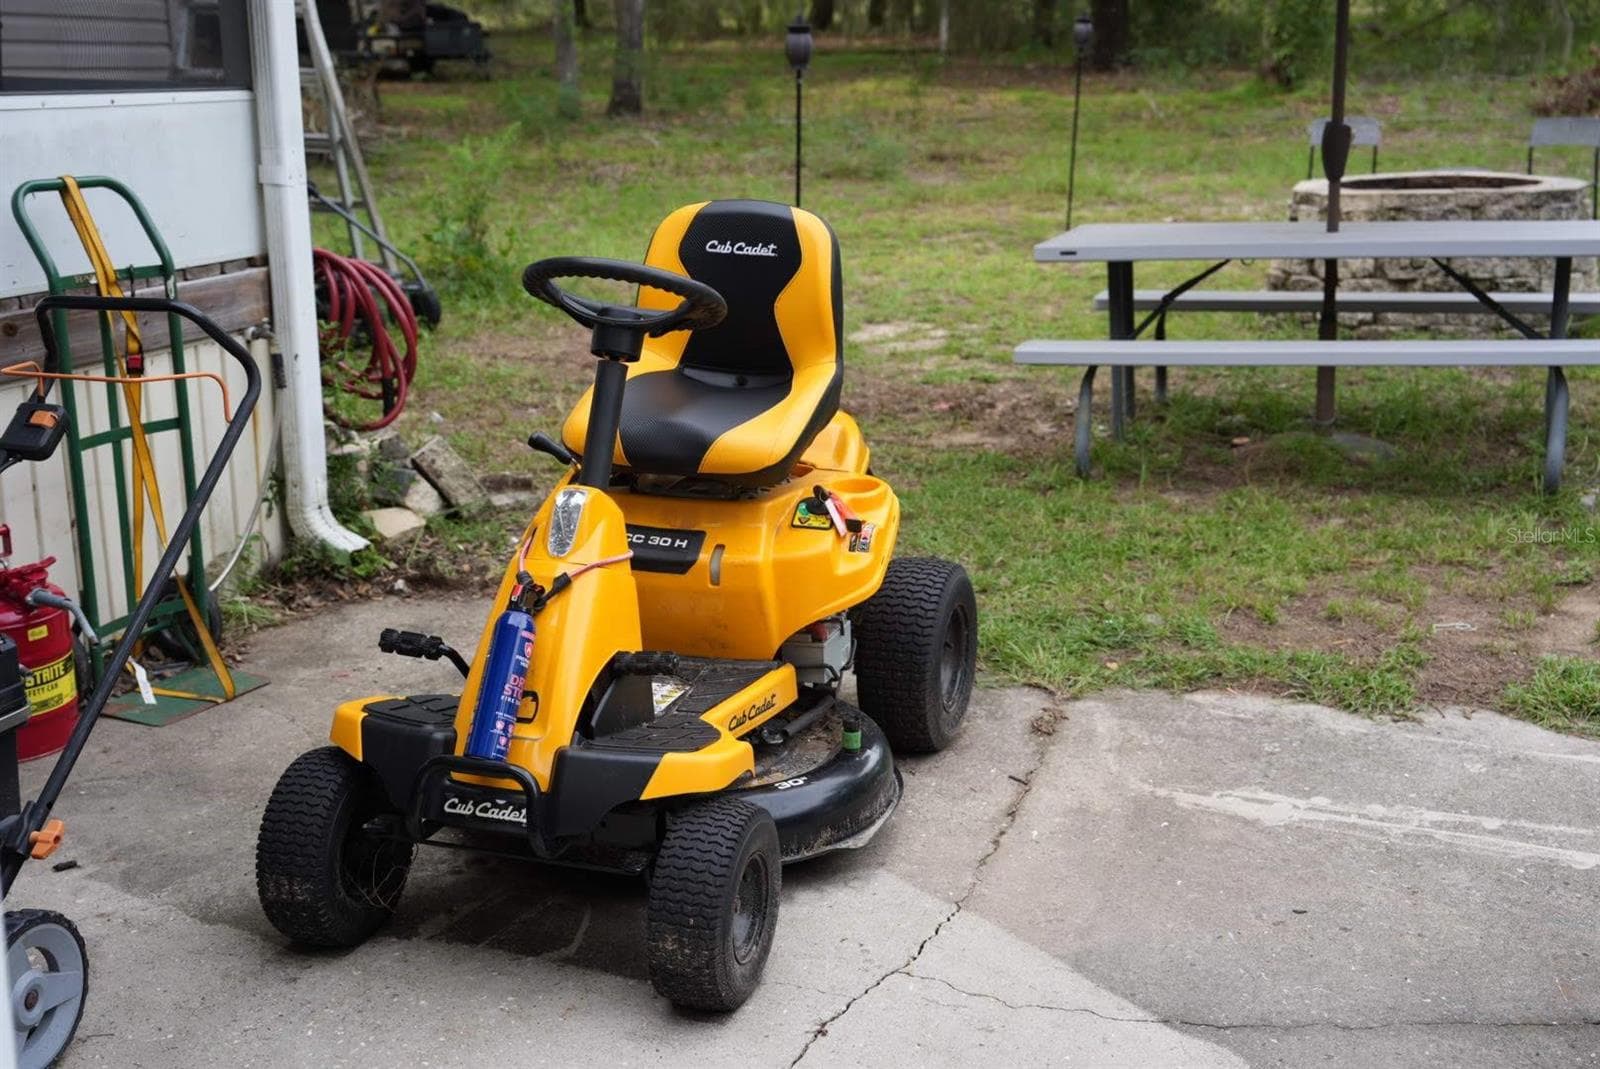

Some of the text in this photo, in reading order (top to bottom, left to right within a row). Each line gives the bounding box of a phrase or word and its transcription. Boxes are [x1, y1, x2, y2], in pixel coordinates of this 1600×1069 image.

[705, 239, 777, 257] Cub Cadet
[648, 535, 672, 547] 30
[673, 539, 689, 549] H
[728, 693, 777, 732] Cub Cadet
[443, 797, 527, 823] Cub Cadet
